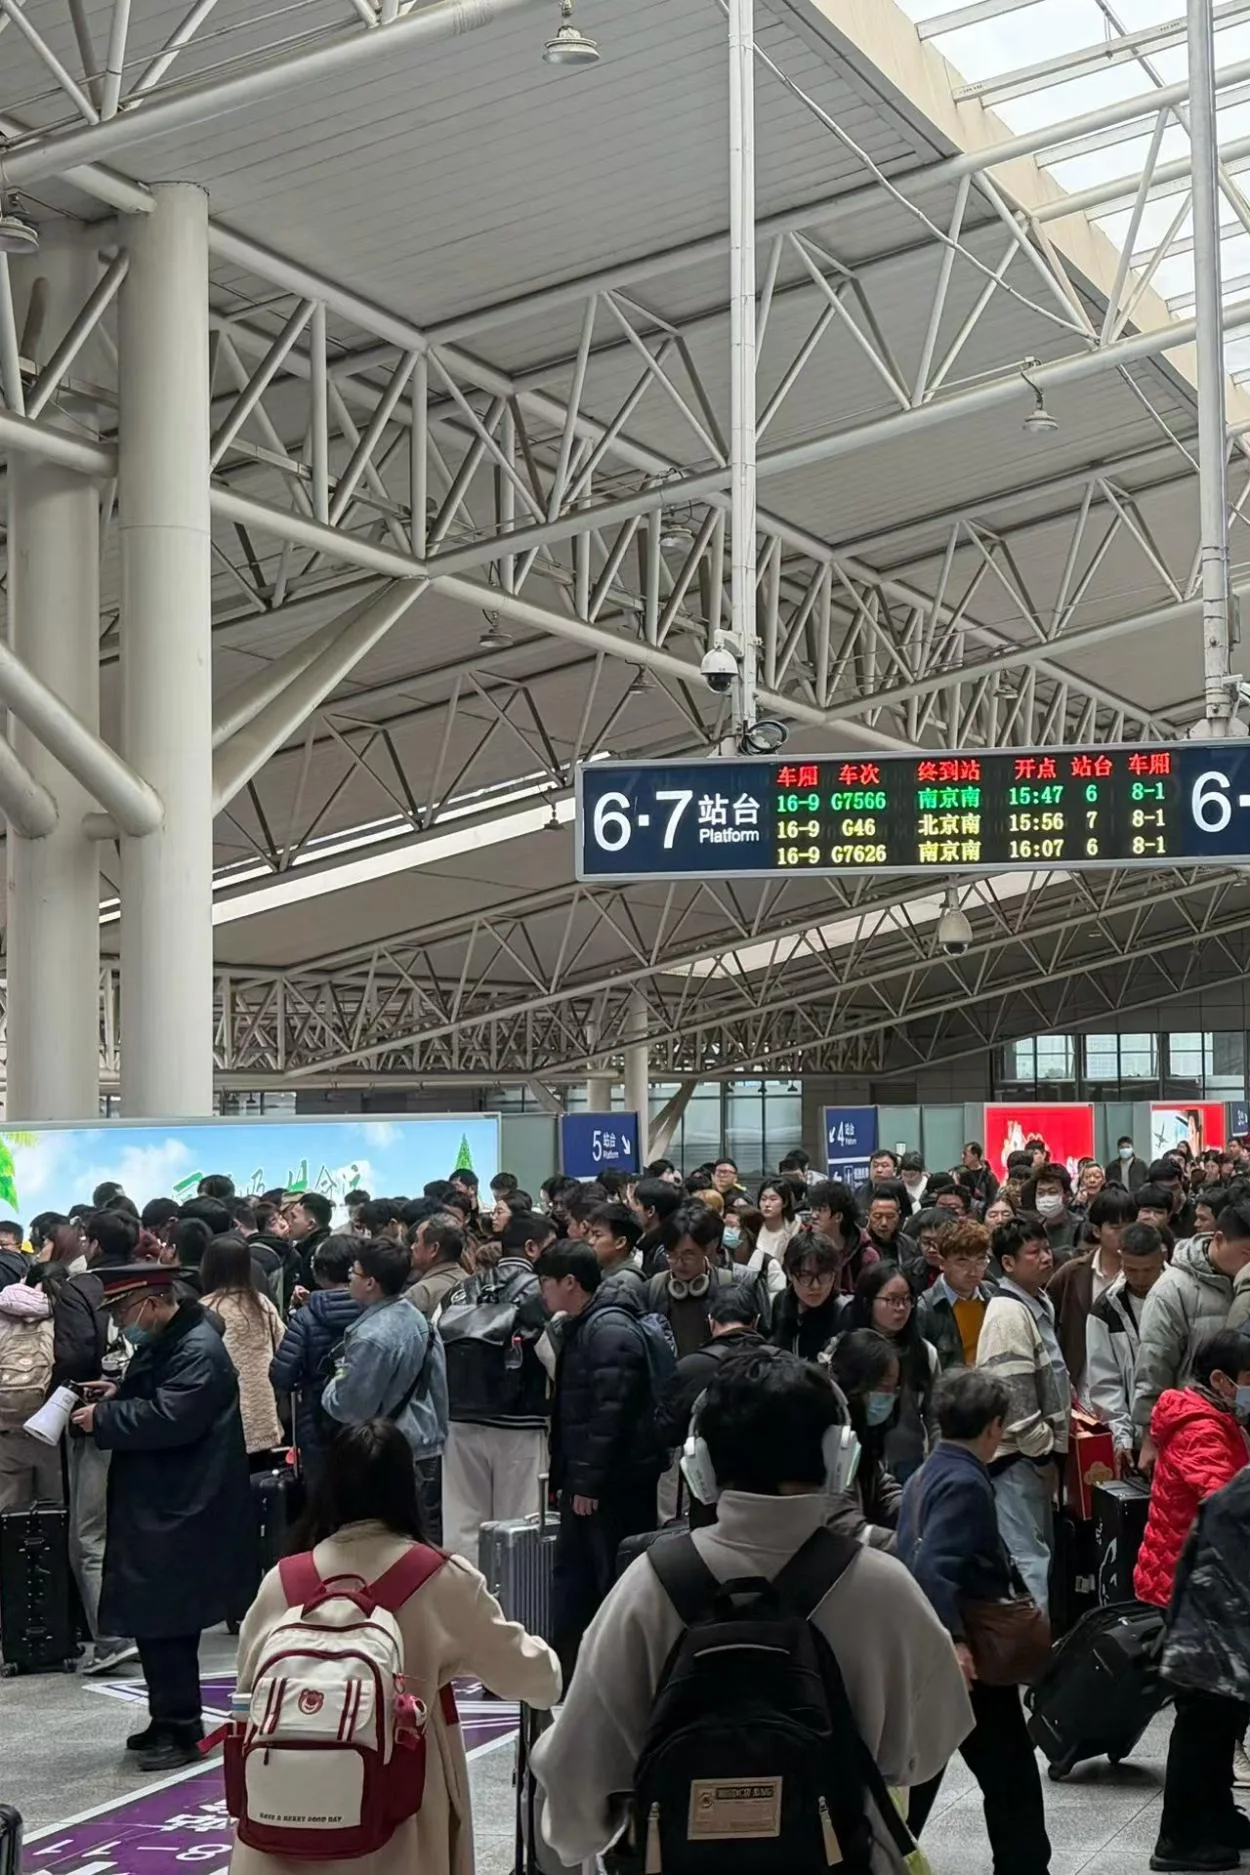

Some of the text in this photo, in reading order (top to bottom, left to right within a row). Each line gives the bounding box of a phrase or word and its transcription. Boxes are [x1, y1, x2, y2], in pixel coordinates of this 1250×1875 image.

[777, 752, 1170, 788] 车厢 车次 终到站 开点 站台 车厢
[698, 793, 760, 826] 站台
[777, 781, 1165, 813] 16-9 G7566 南京南 15:47 6 8-1
[699, 827, 760, 844] Platform
[777, 808, 1166, 839] 16-9 G46 北京南 15:56 7 8-1
[777, 835, 1166, 865] 16-9 G7626 南京南 16:07 6 8-1
[592, 1130, 602, 1162] 5
[602, 1131, 617, 1148] 站台
[837, 1121, 845, 1147] 4
